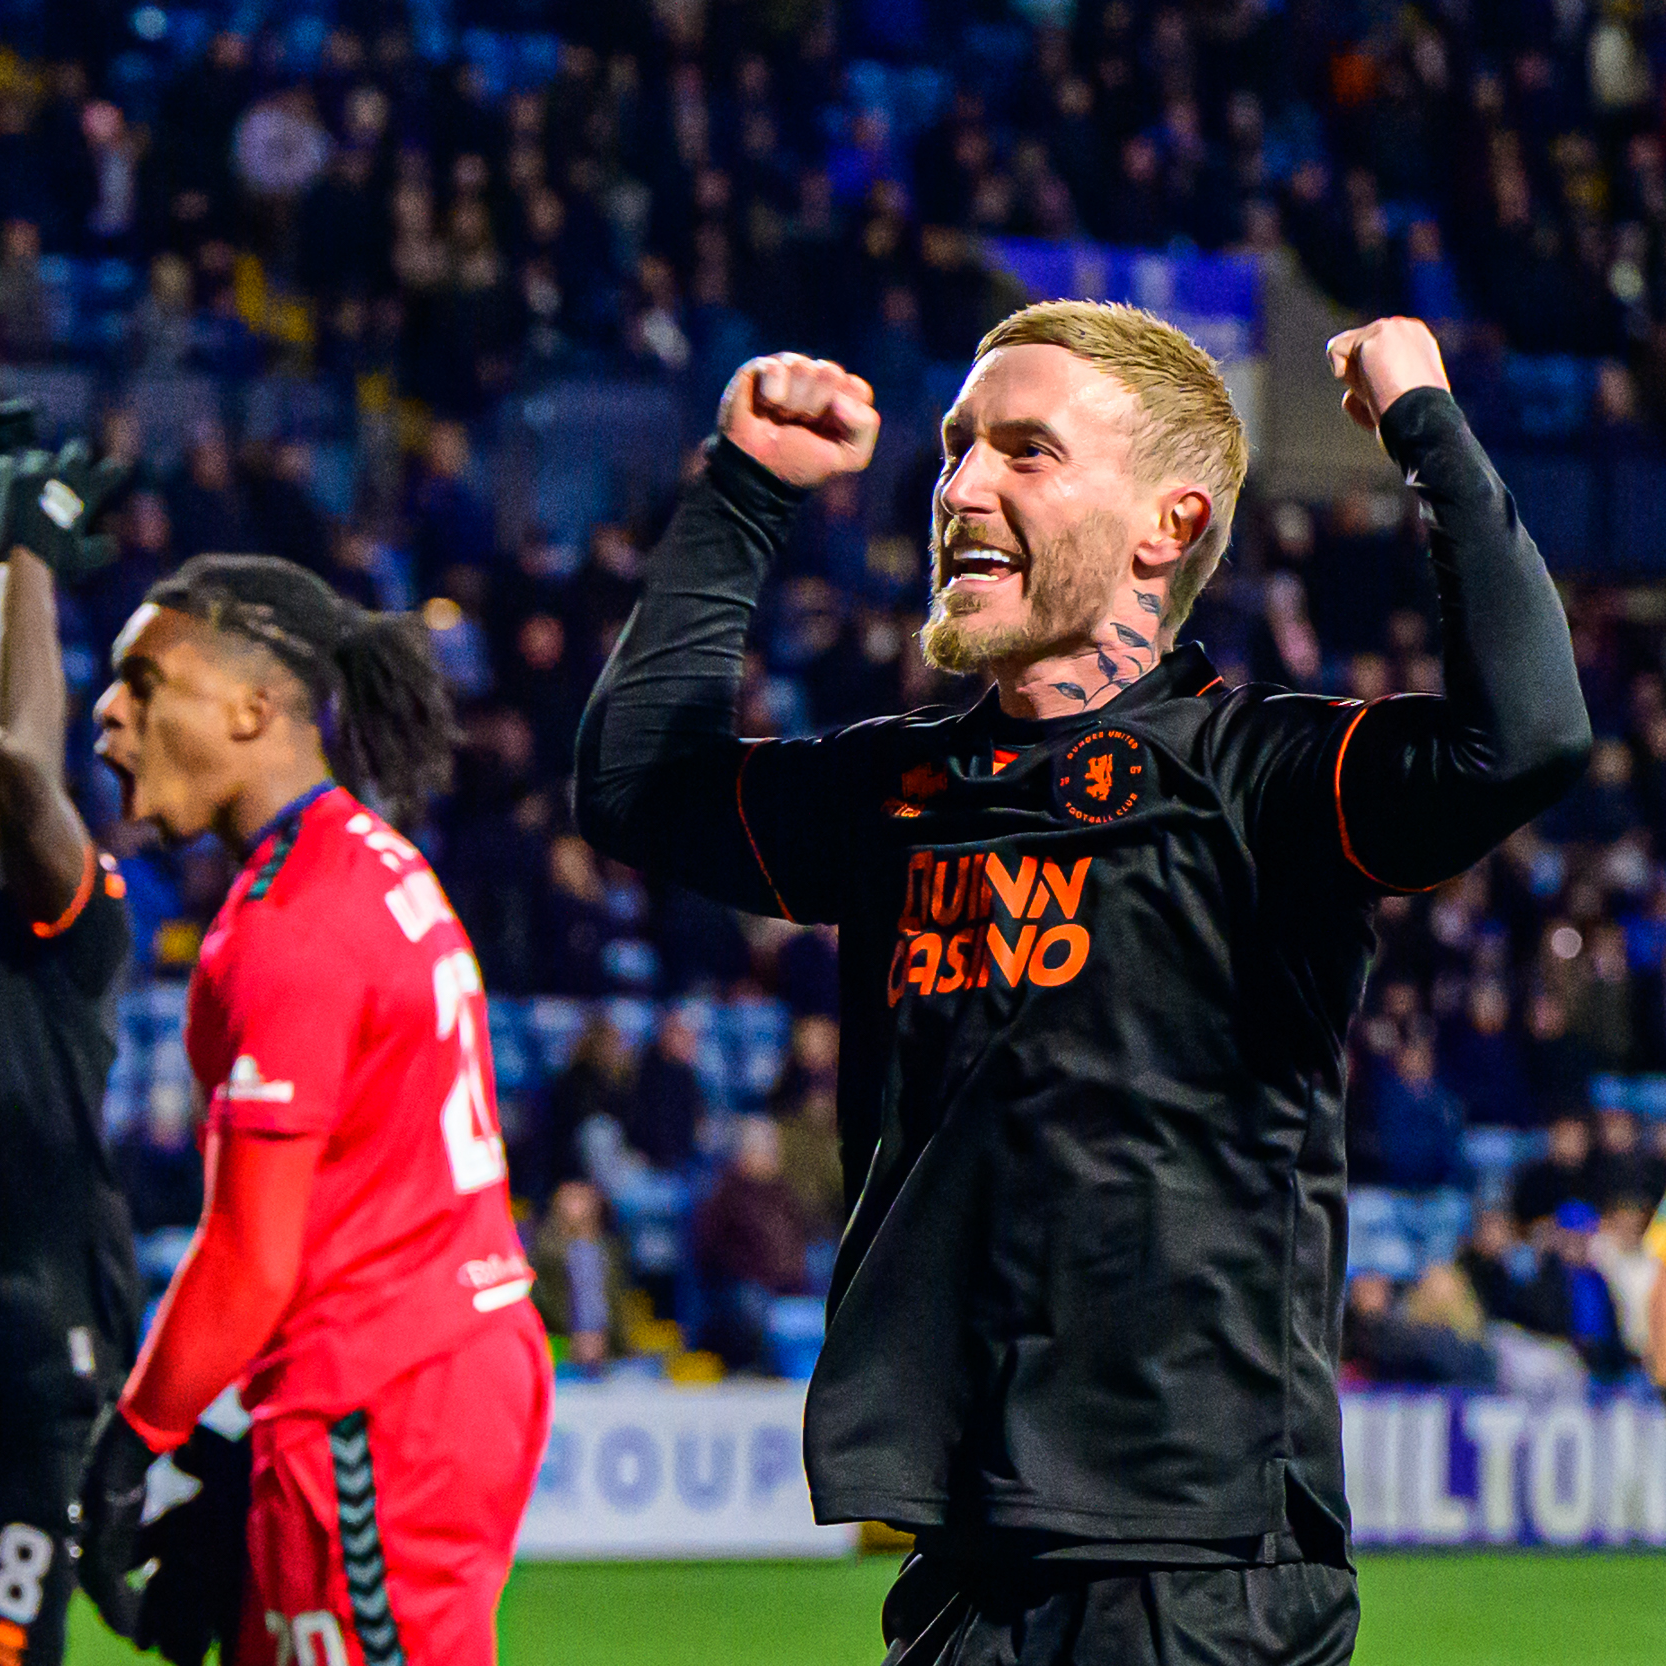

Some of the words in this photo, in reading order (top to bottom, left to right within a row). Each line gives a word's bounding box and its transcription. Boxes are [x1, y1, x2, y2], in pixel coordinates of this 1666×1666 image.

[1108, 729, 1139, 750] UNITED
[1065, 801, 1113, 824] FOOTBALL
[1116, 792, 1138, 816] CLUB
[538, 1422, 803, 1513] ROUP
